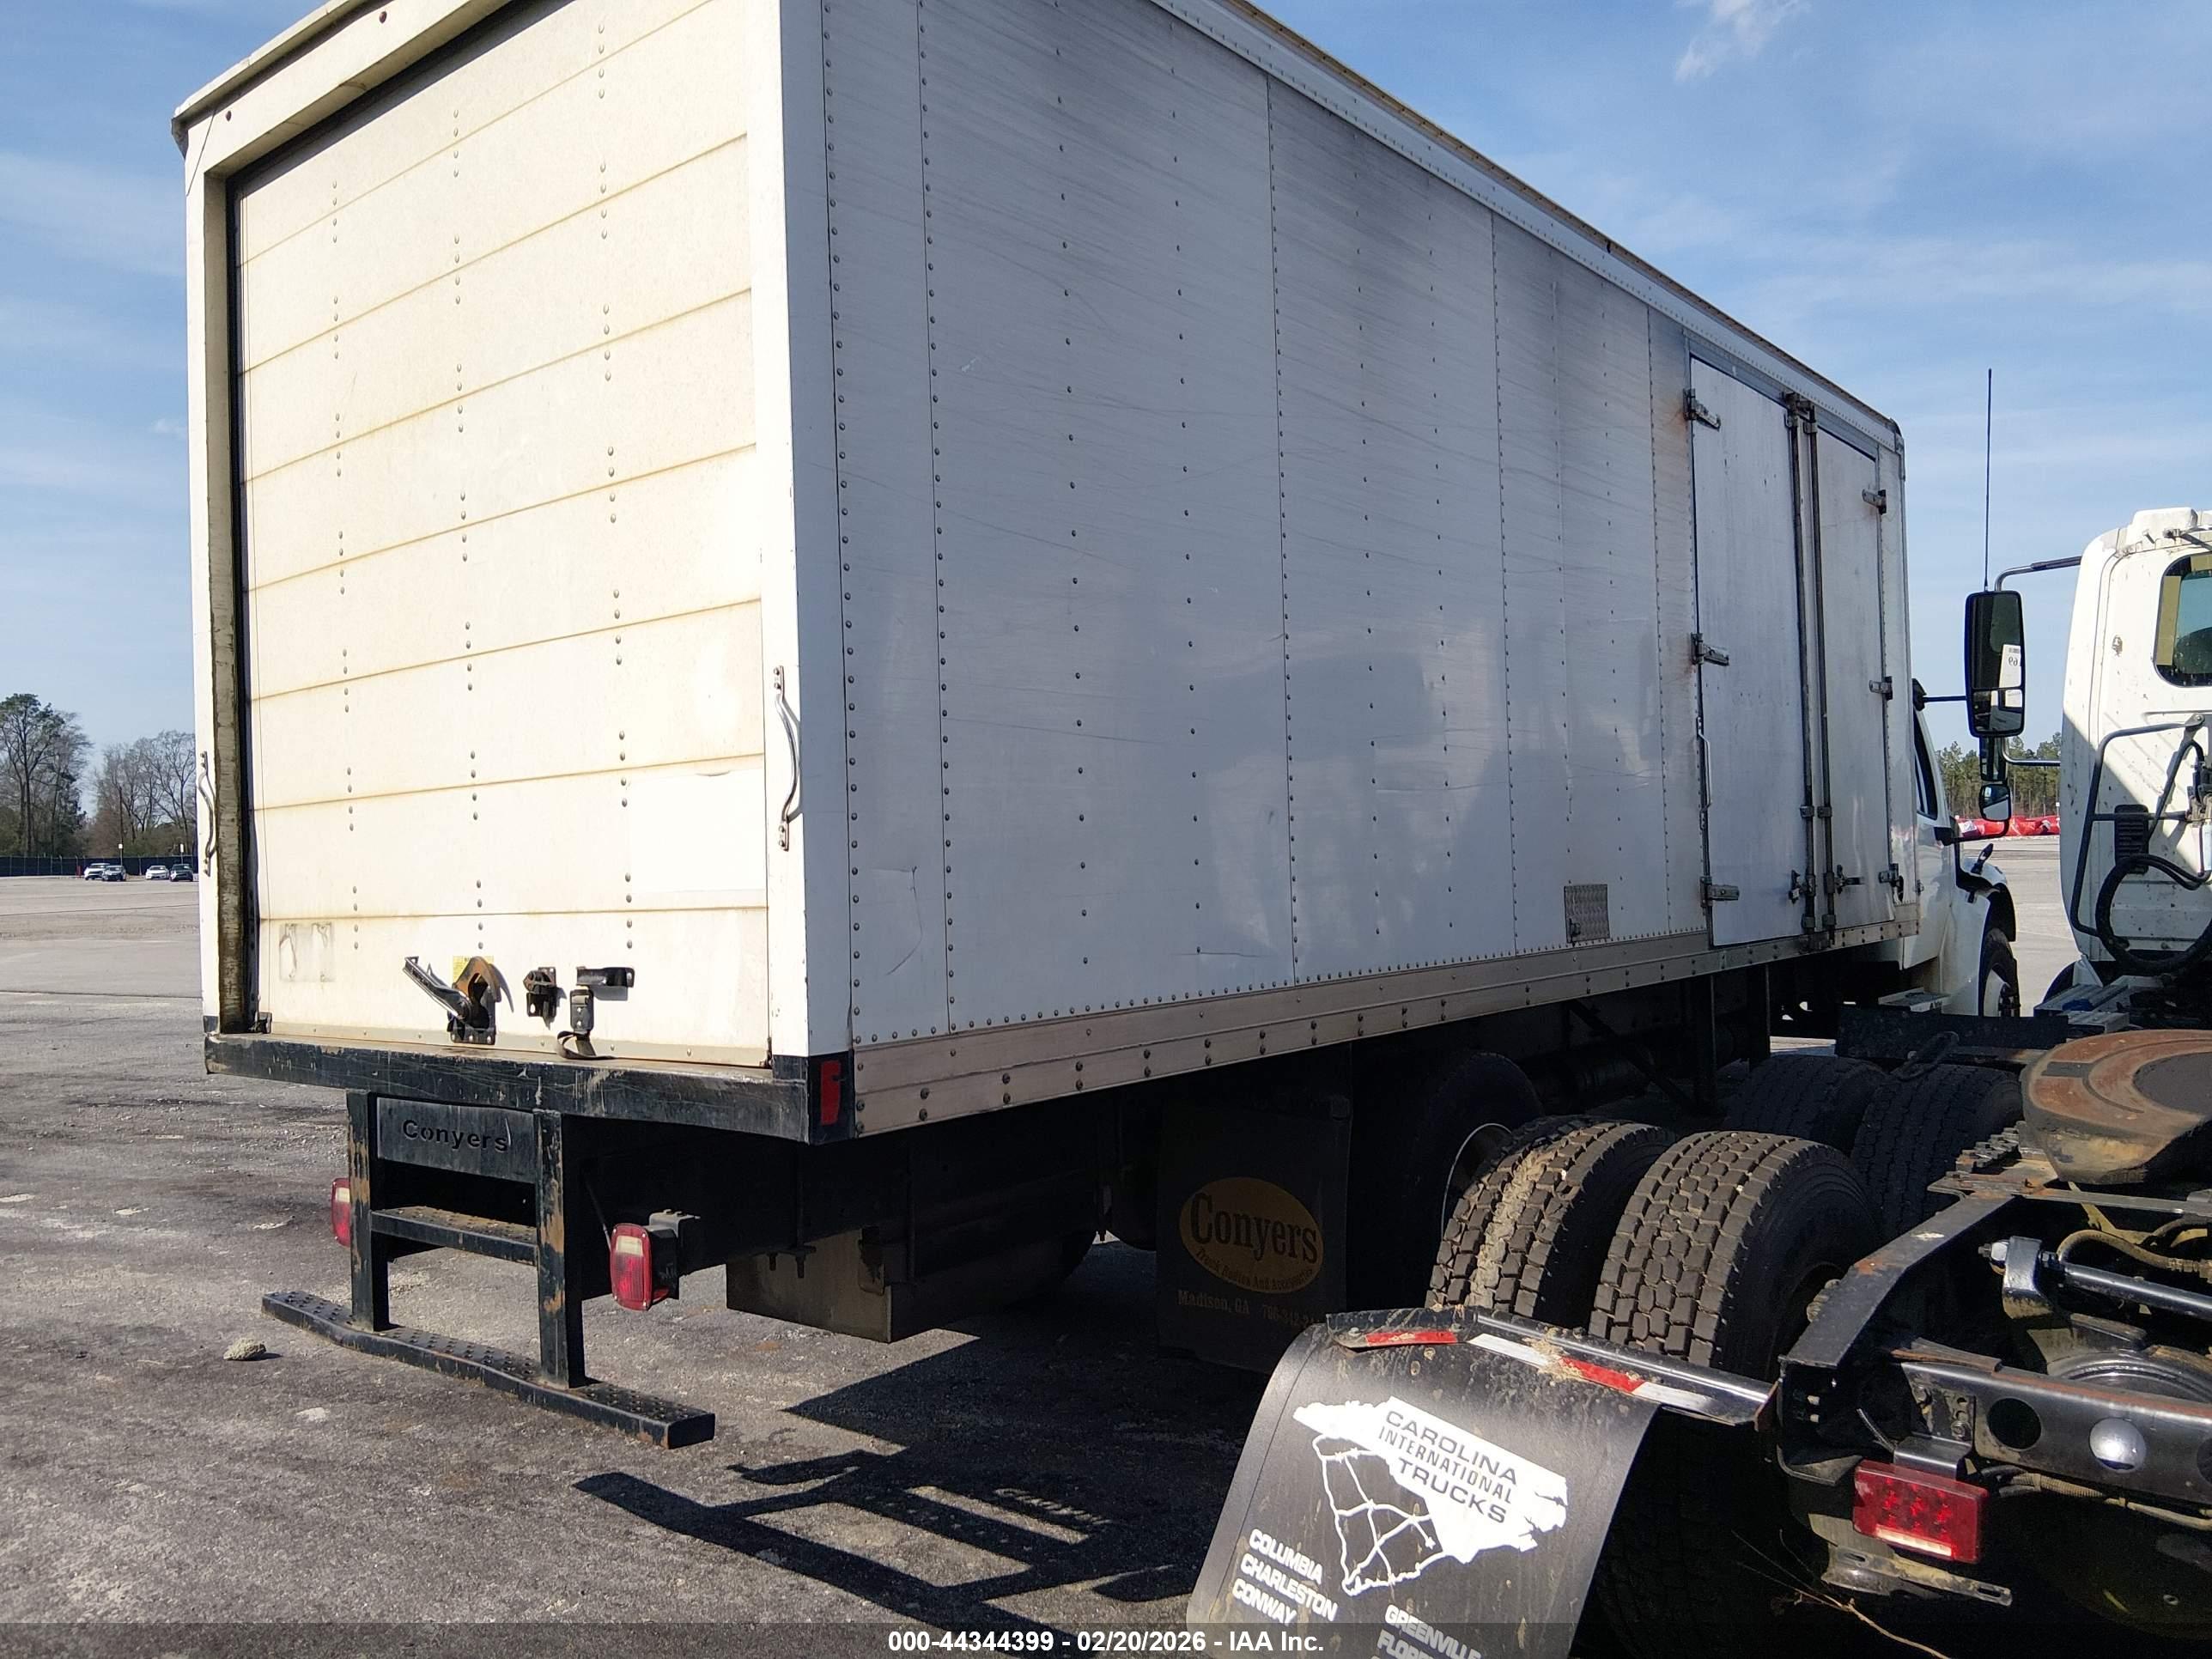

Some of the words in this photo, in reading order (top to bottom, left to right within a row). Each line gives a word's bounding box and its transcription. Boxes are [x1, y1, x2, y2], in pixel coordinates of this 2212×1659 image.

[403, 1120, 508, 1152] Conyers
[1190, 1193, 1317, 1264] Conyers
[1178, 1290, 1232, 1313] Madison,
[1235, 1297, 1250, 1316] GA
[1378, 1425, 1512, 1504] INTERNATIONAL
[1385, 1410, 1516, 1485] CAROLINA
[1397, 1458, 1507, 1524] TRUCKS
[1249, 1528, 1323, 1585] COLUMBIA
[1232, 1577, 1297, 1626] CONWAY
[1240, 1553, 1339, 1622] CHARLESTON
[1385, 1604, 1481, 1659] GREENVILLE
